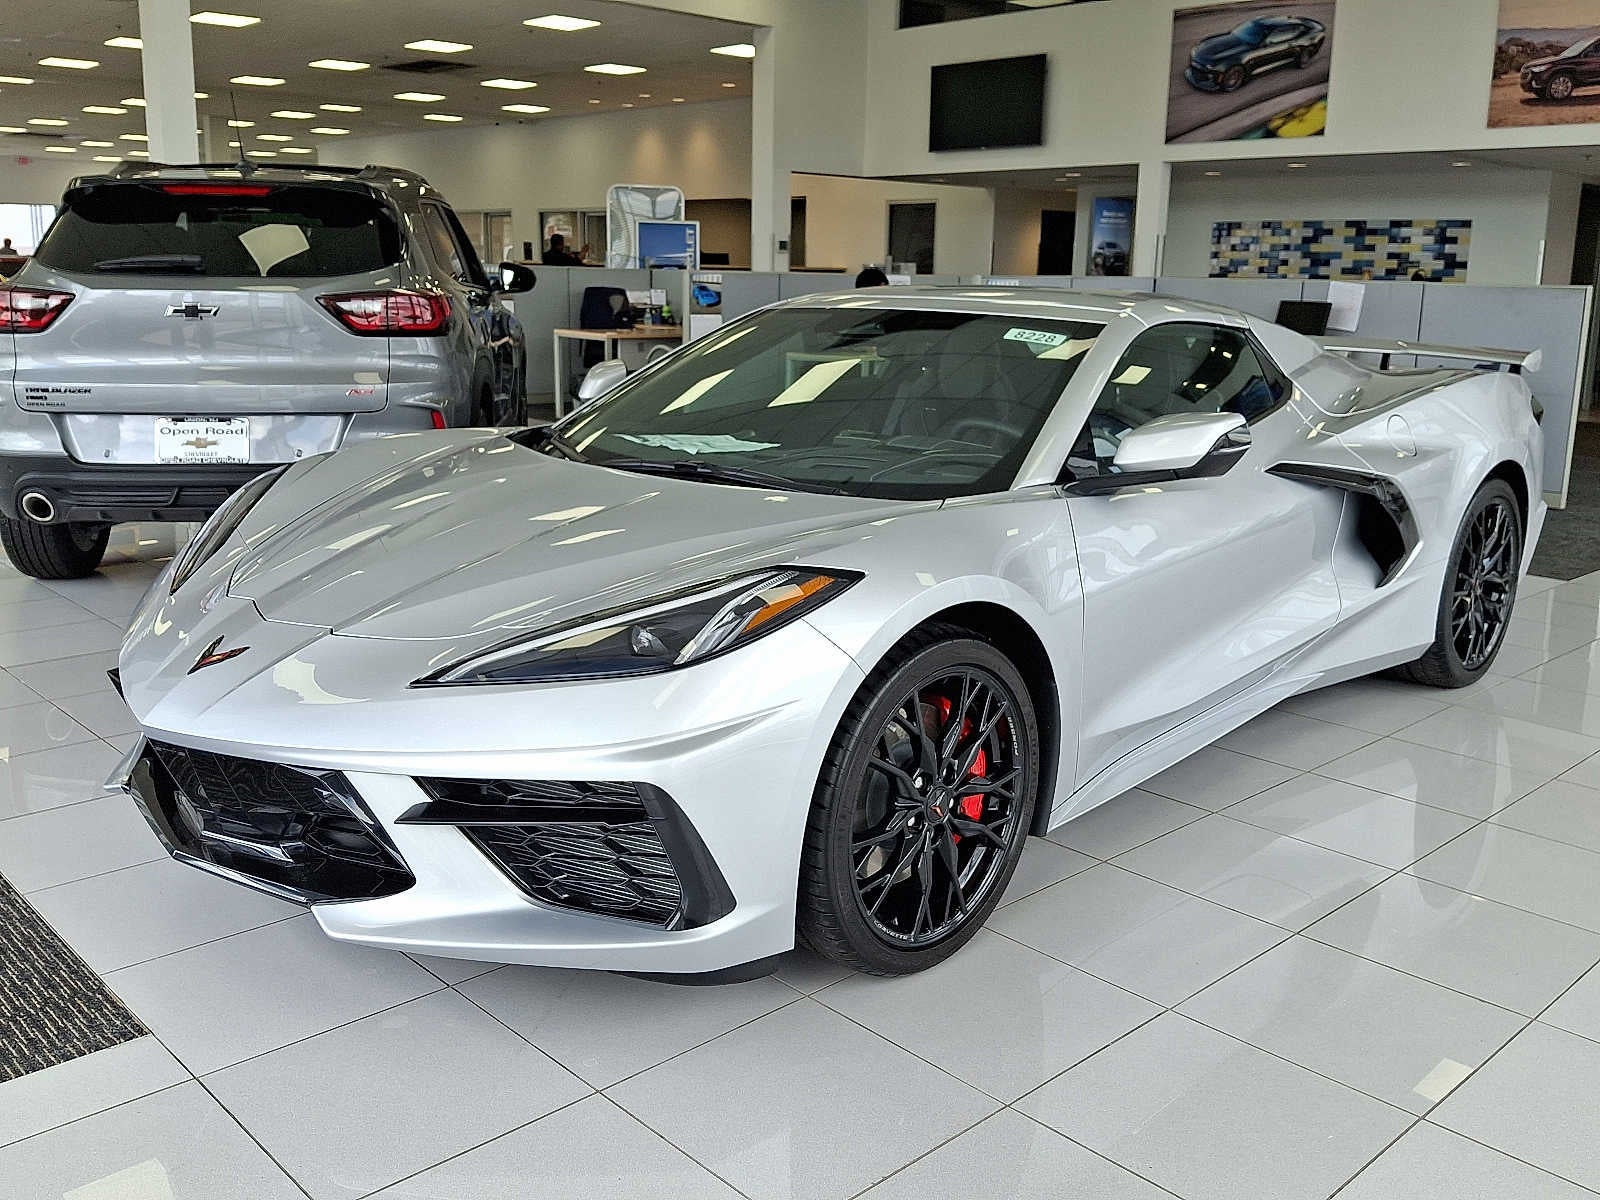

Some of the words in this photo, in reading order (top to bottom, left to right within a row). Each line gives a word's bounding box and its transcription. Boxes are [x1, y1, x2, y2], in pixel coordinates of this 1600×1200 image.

[1014, 331, 1057, 343] 8228
[160, 426, 200, 437] Open
[205, 426, 244, 436] Road
[873, 919, 909, 940] CORVETTE
